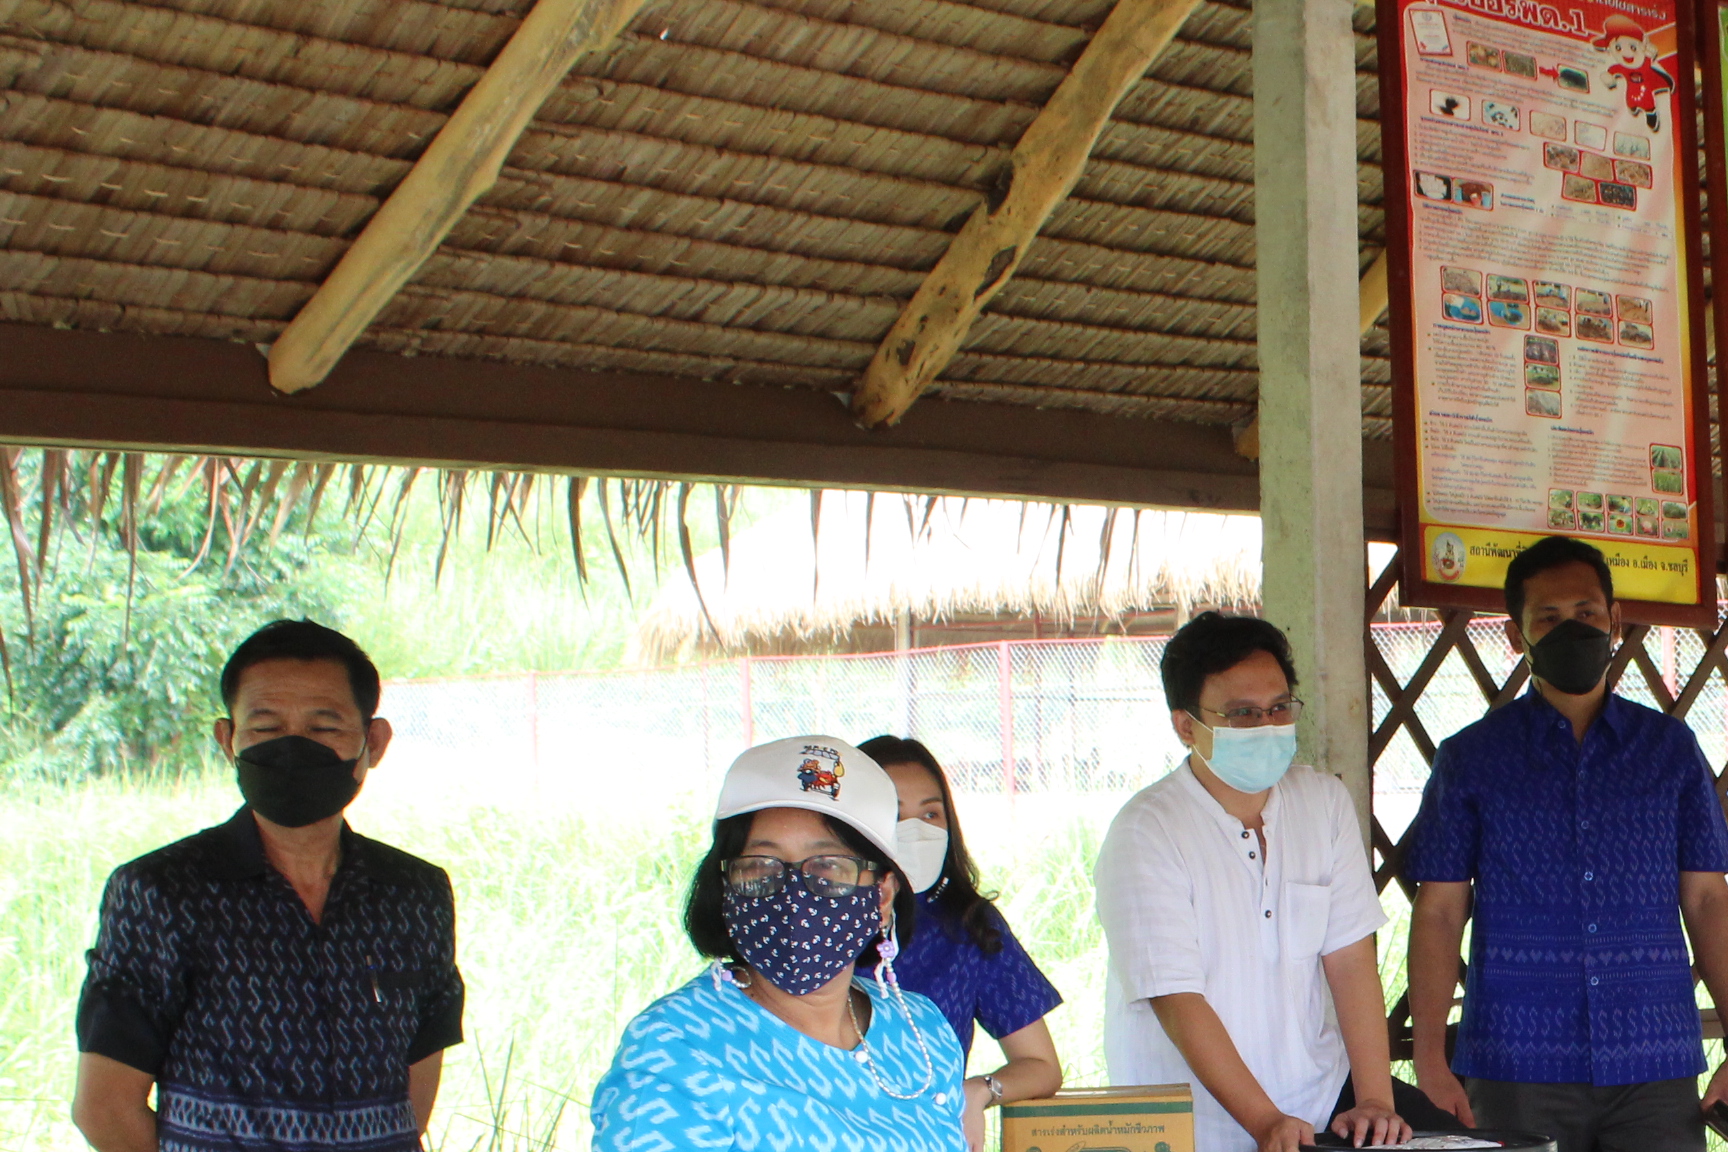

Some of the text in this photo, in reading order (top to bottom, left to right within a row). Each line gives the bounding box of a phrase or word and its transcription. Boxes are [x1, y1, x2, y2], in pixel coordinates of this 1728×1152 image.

[1031, 1120, 1165, 1138] สารเร่งสำหรับผลิตน้ำหมักชีวภาพ
